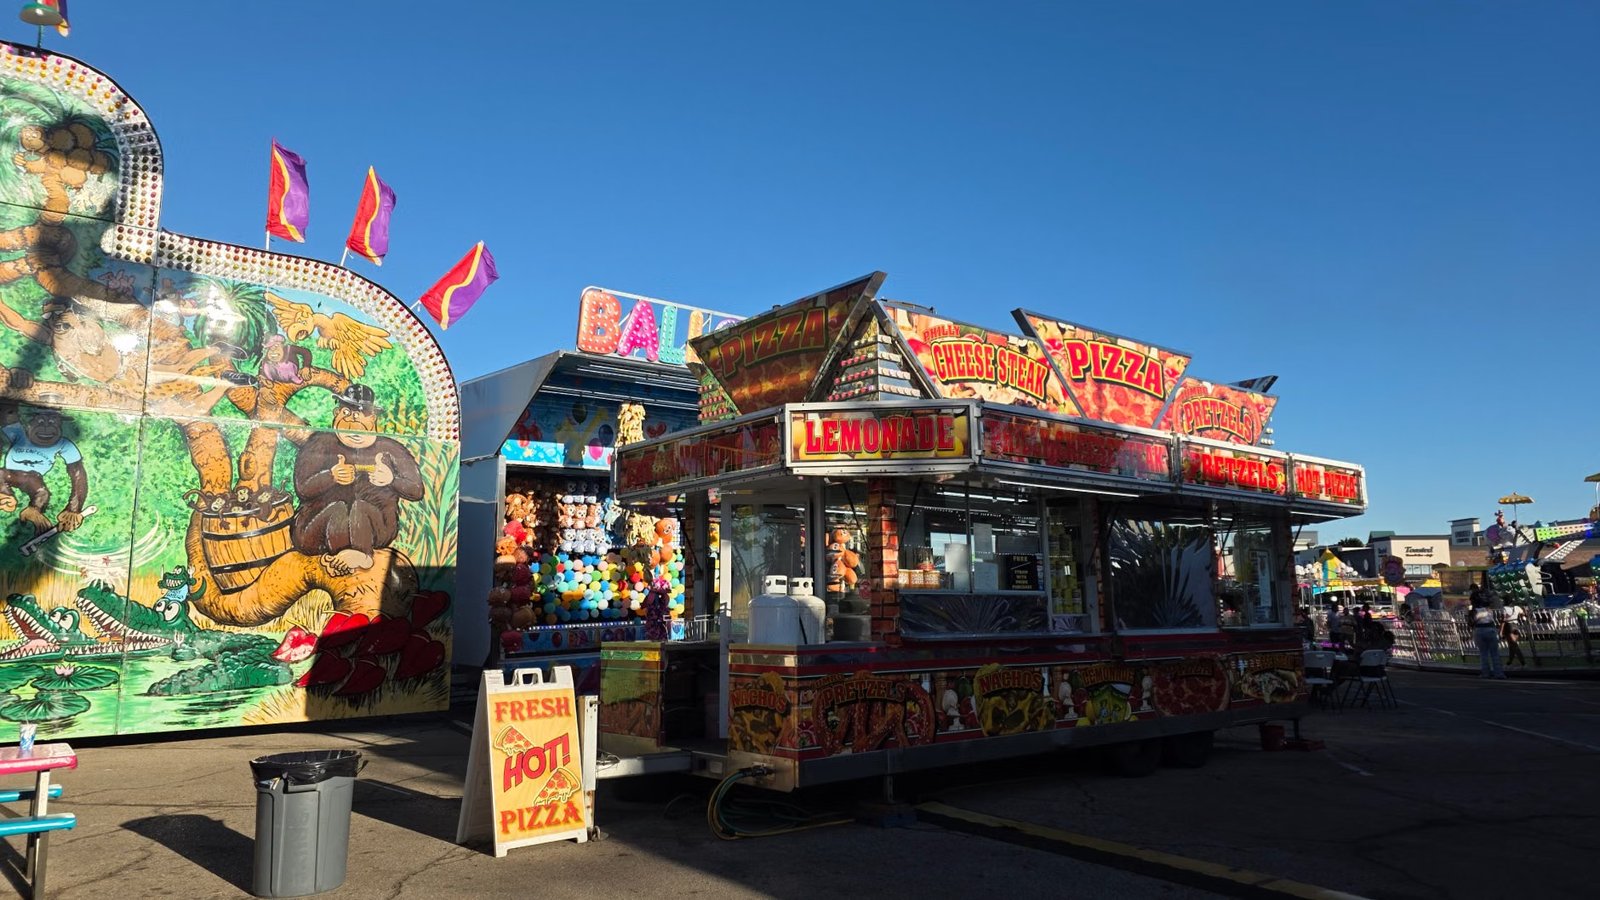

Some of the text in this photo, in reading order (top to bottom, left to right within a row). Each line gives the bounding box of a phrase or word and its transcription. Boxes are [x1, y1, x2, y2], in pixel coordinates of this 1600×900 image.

[719, 307, 827, 377] PIZZA
[923, 324, 961, 342] PHILLY
[930, 339, 1050, 401] CHEESE STEAK
[1063, 338, 1166, 400] PIZZA
[804, 416, 956, 456] LEMONADE
[1182, 396, 1256, 445] PRETZELS
[1296, 471, 1357, 500] HOT PIZZA
[820, 679, 907, 708] PRETZELS
[978, 669, 1042, 694] NACHOS
[494, 696, 572, 723] FRESH
[730, 689, 788, 713] NACHOS
[503, 732, 571, 792] HOT!
[500, 800, 583, 834] PIZZA
